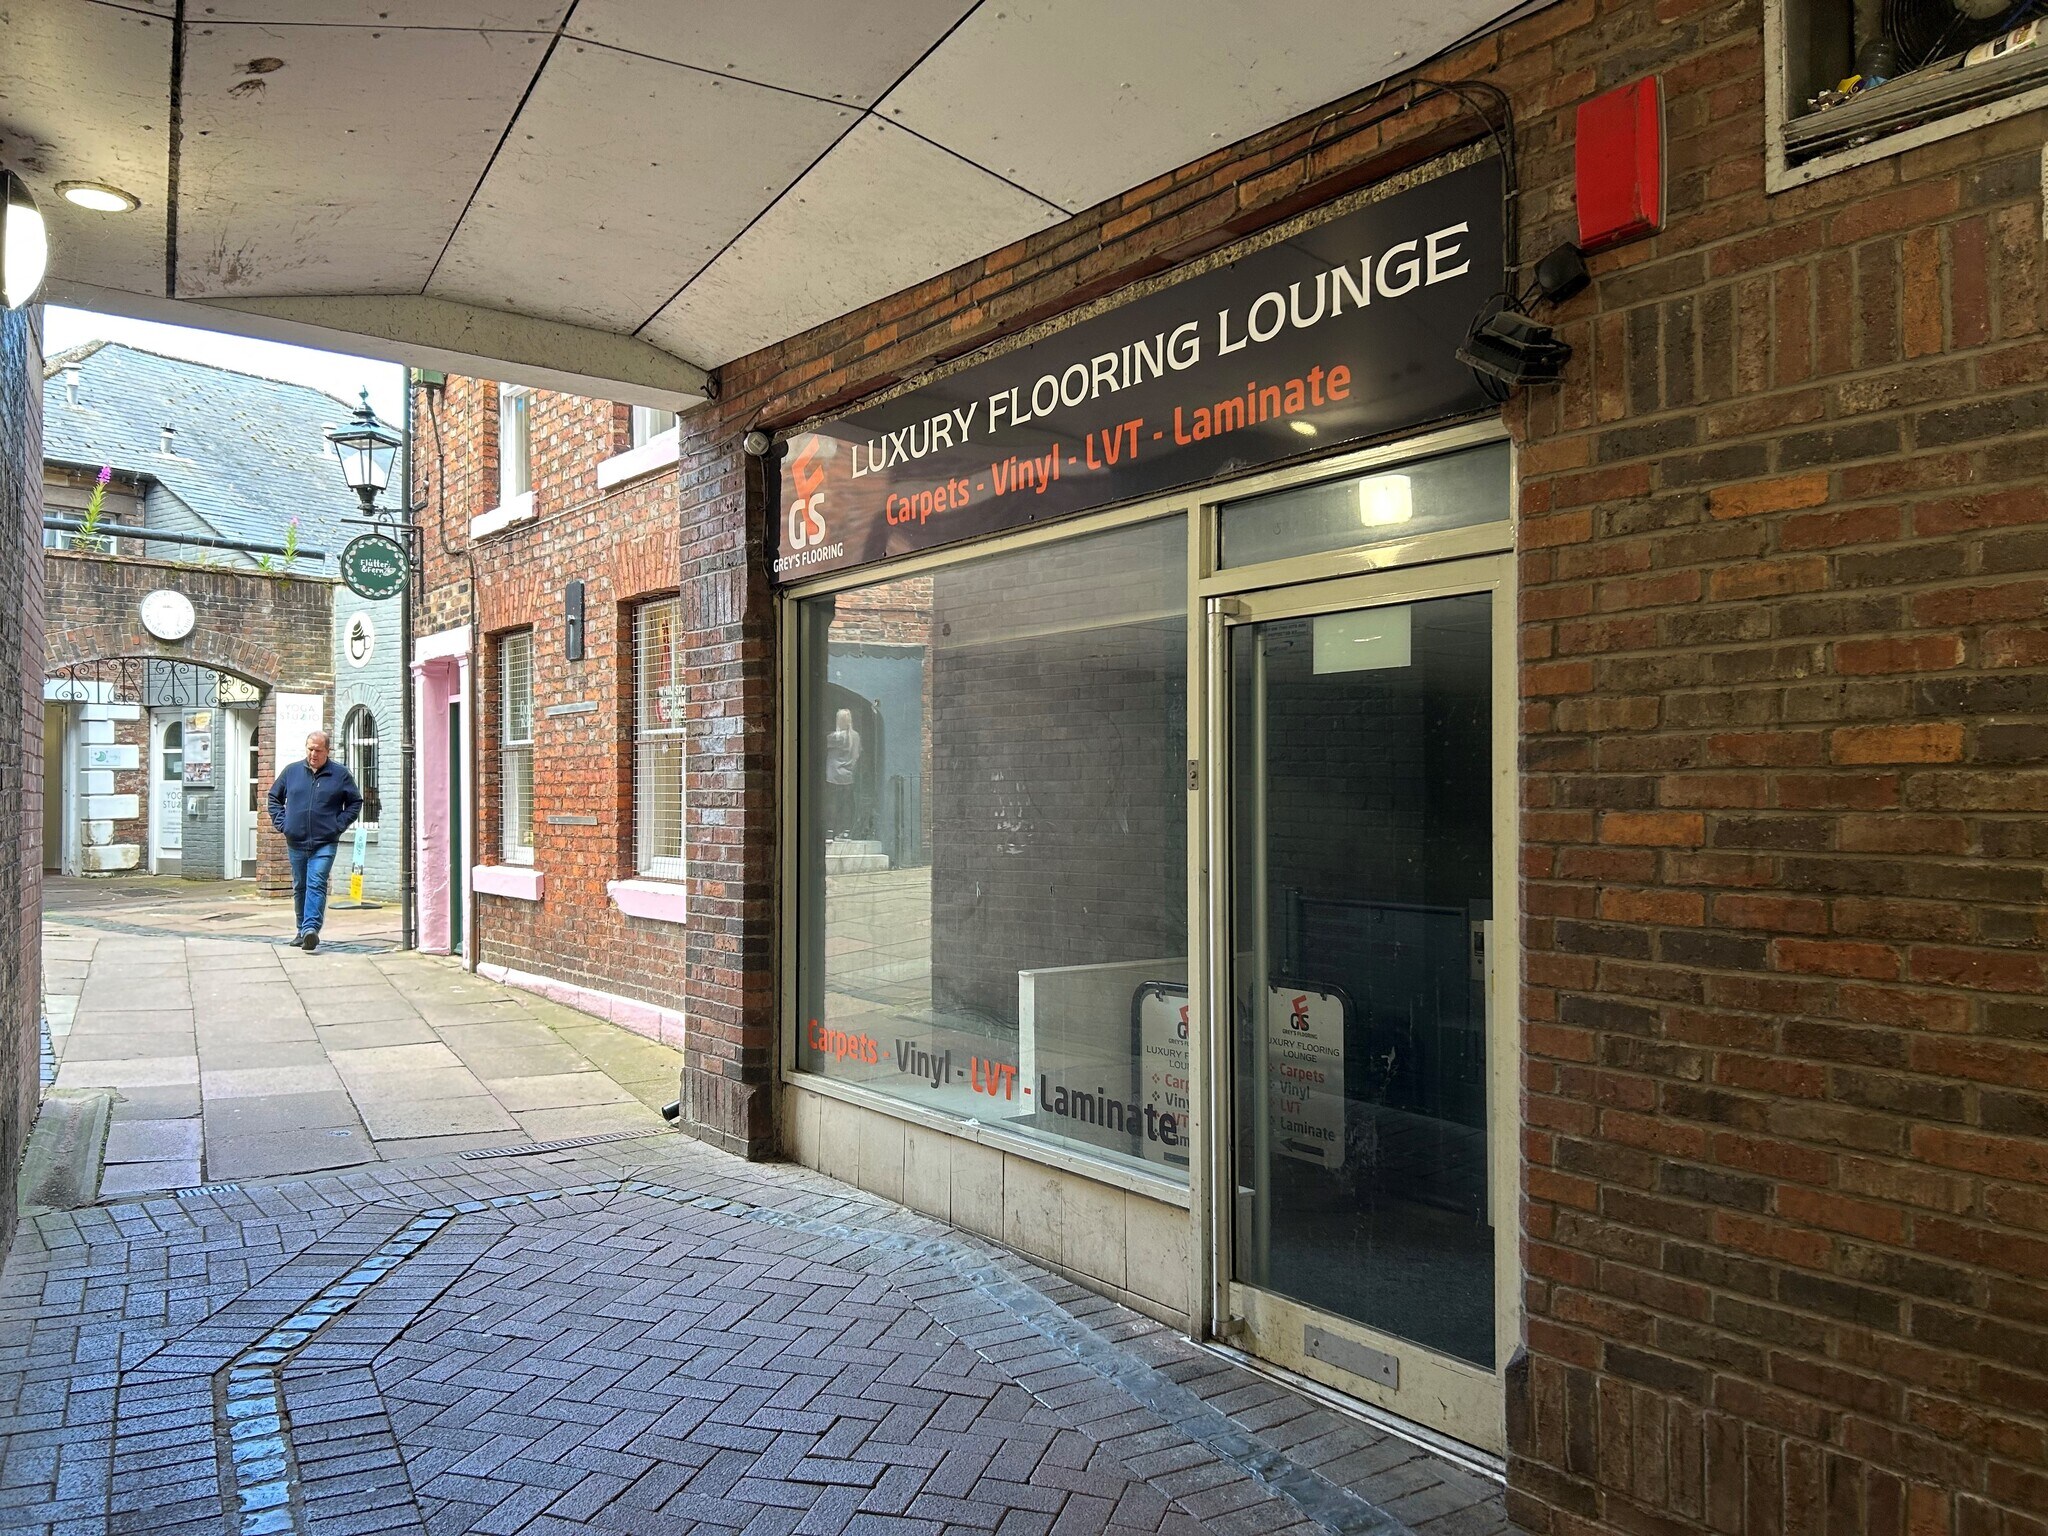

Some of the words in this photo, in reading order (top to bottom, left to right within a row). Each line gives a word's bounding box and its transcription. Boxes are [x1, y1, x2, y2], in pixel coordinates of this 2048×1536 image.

[851, 401, 978, 479] LUXURY
[989, 321, 1200, 434] FLOORING
[1218, 221, 1471, 356] LOUNGE
[886, 478, 969, 526] Carpets
[976, 483, 984, 491] -
[991, 443, 1059, 496] Vinyl
[1068, 457, 1077, 465] -
[1086, 418, 1144, 470] LVT
[1153, 431, 1163, 440] -
[1174, 364, 1351, 446] Laminate
[773, 553, 801, 573] GREY'S
[801, 543, 844, 566] FLOORING
[285, 704, 315, 712] YOGA
[1146, 1045, 1182, 1059] LUXURY
[1283, 1050, 1318, 1063] LOUNGE
[1298, 1042, 1340, 1056] FLOORING
[808, 1018, 878, 1065] Carpets
[895, 1039, 950, 1089] Vinyl
[971, 1056, 1017, 1100] LVT
[1040, 1074, 1178, 1146] Laminate
[1280, 1062, 1325, 1083] Carpets
[1280, 1081, 1310, 1100] Vinyl
[1280, 1099, 1302, 1114] LVT
[1280, 1116, 1336, 1141] Laminate
